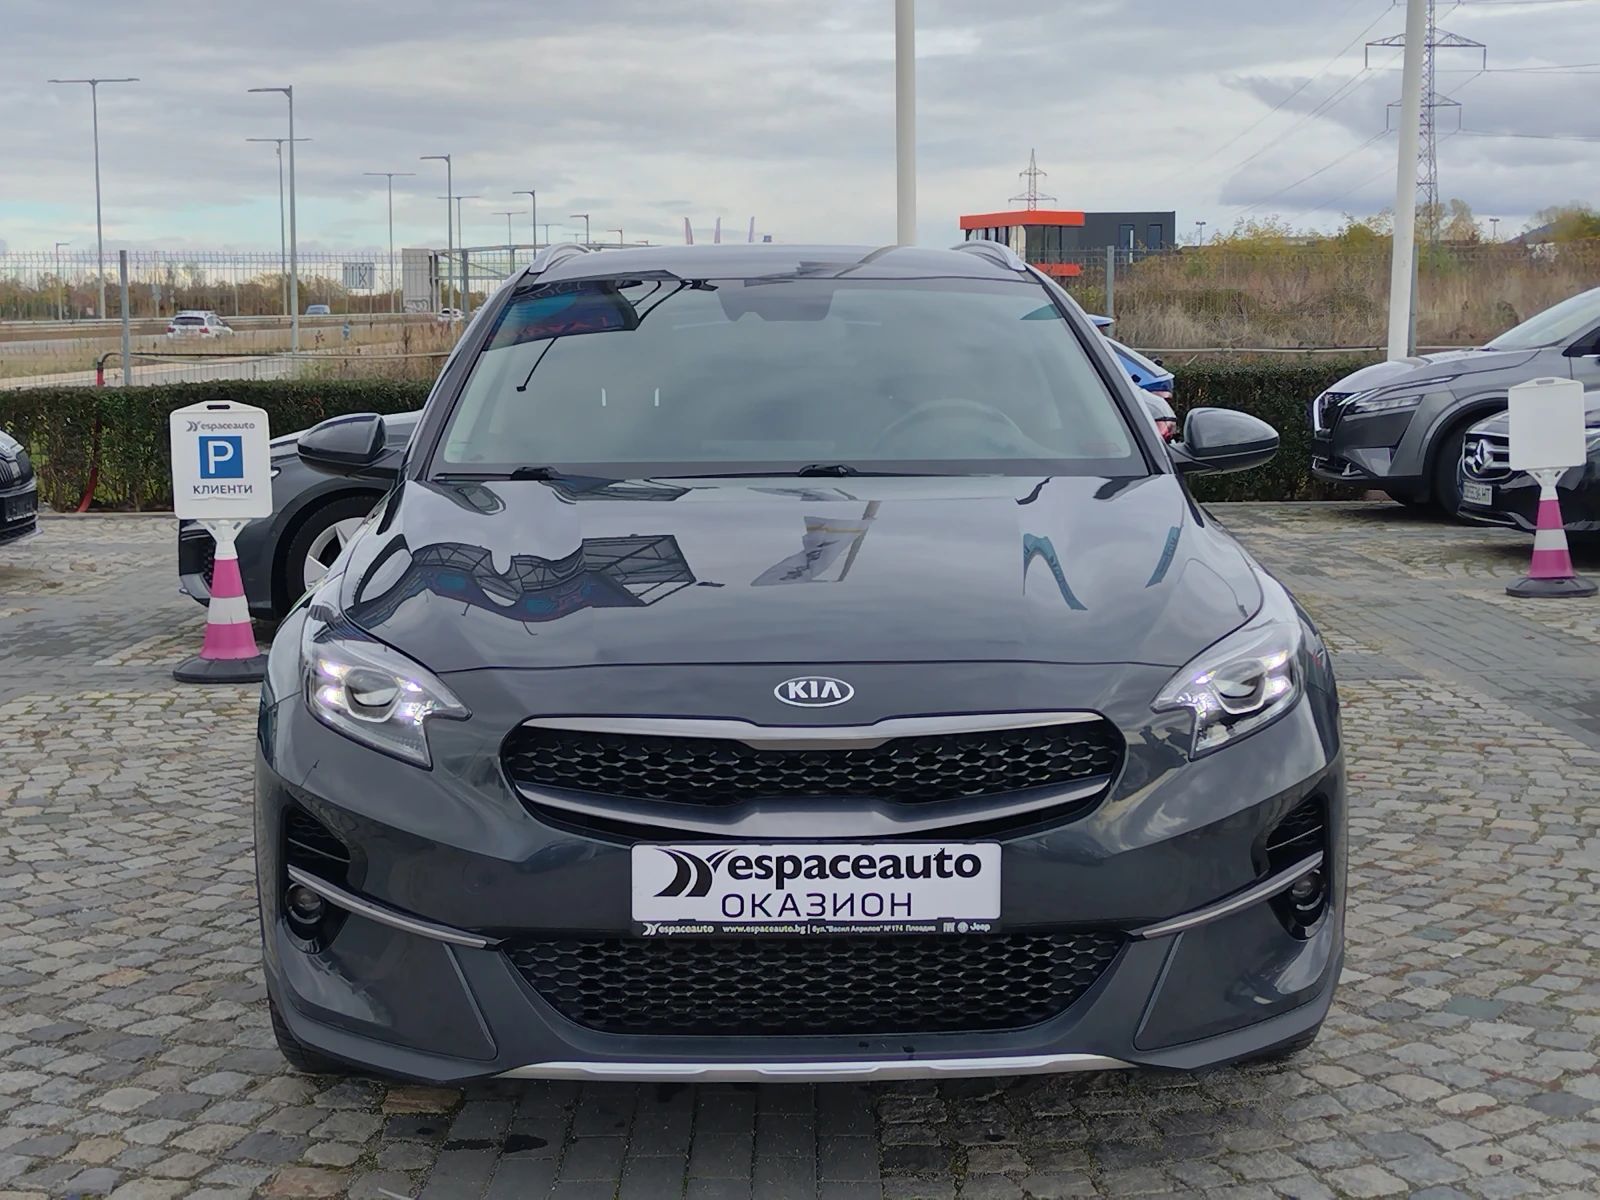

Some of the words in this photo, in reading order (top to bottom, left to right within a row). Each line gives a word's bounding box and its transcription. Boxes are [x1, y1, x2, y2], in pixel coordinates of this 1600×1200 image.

[200, 422, 256, 432] espaceauto
[207, 440, 234, 475] P
[193, 484, 253, 495] КЛИЕНТИ
[787, 680, 842, 699] KIA
[727, 847, 982, 890] espaceauto
[721, 892, 912, 918] ОКАЗИОН
[658, 923, 715, 935] espaceauto
[722, 923, 807, 935] www.espaceauto.bg
[969, 922, 991, 933] Jeep
